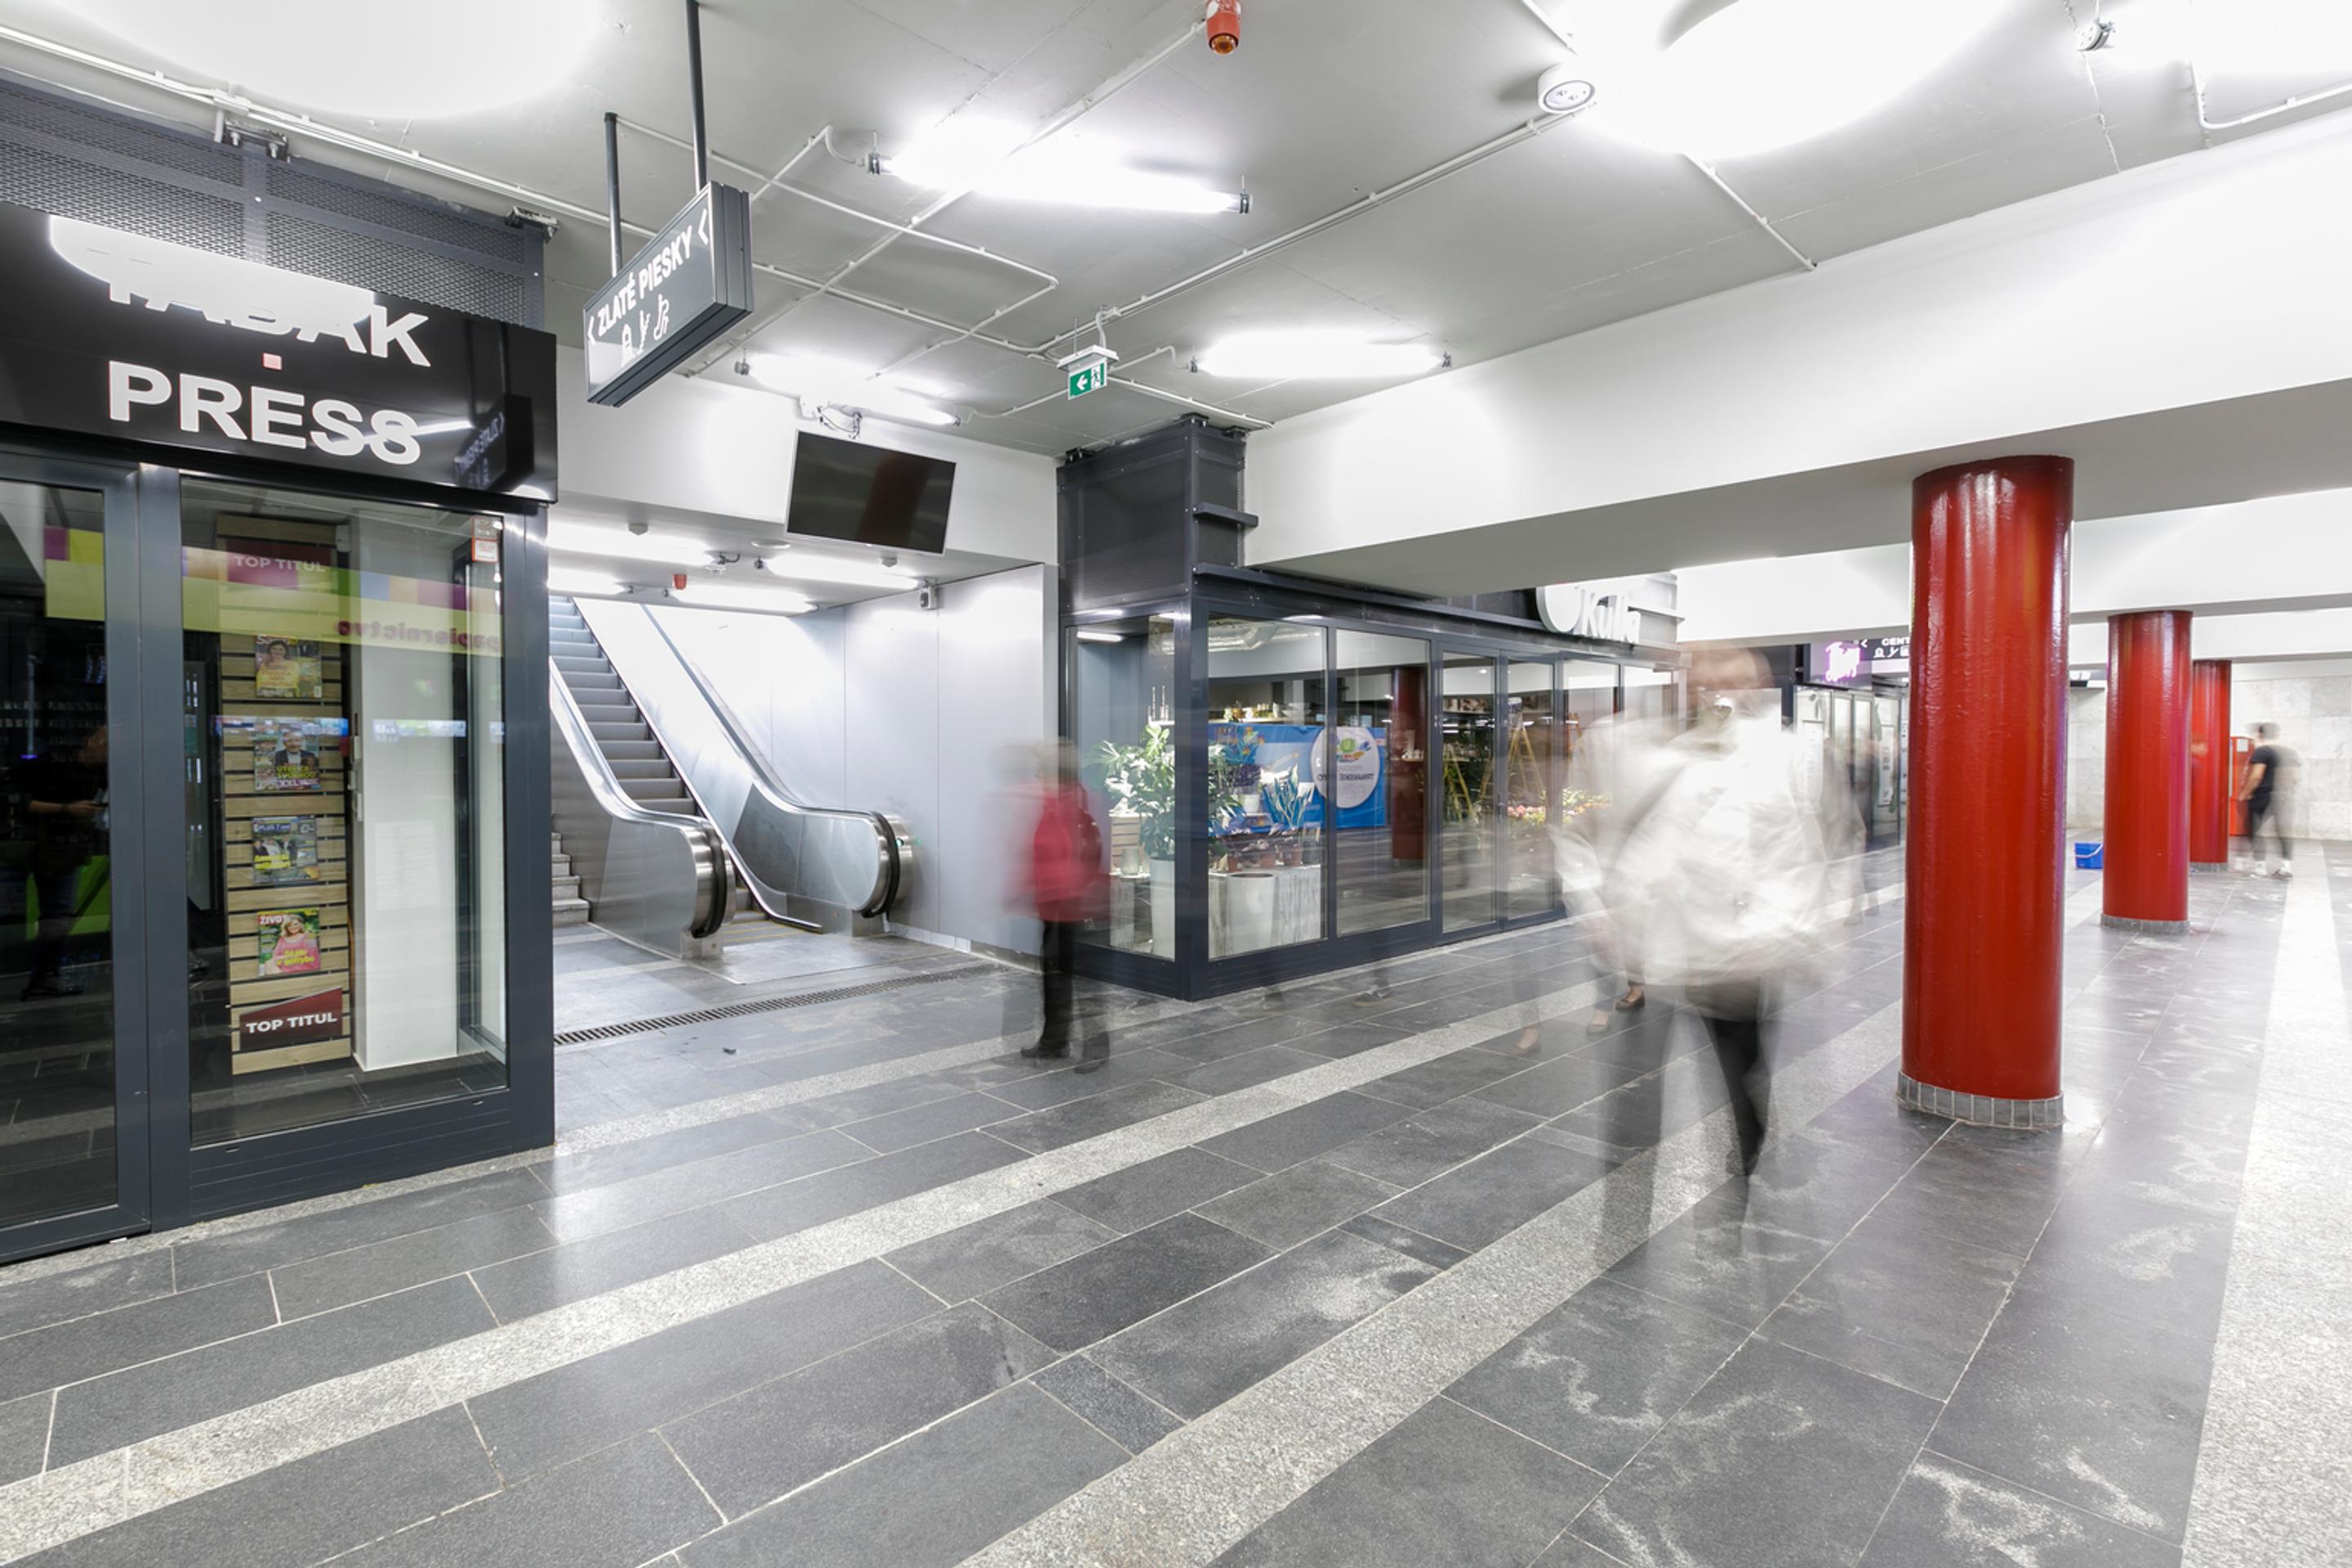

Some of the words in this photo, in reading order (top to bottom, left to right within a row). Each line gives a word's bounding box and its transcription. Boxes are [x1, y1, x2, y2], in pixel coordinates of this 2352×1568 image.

[597, 271, 637, 337] ZLATÉ
[639, 225, 693, 300] PIESKY
[108, 360, 421, 466] PRESS
[234, 555, 272, 569] TOP
[275, 558, 327, 573] TITUL
[246, 1019, 283, 1034] TOP
[287, 1012, 338, 1028] TITUL
